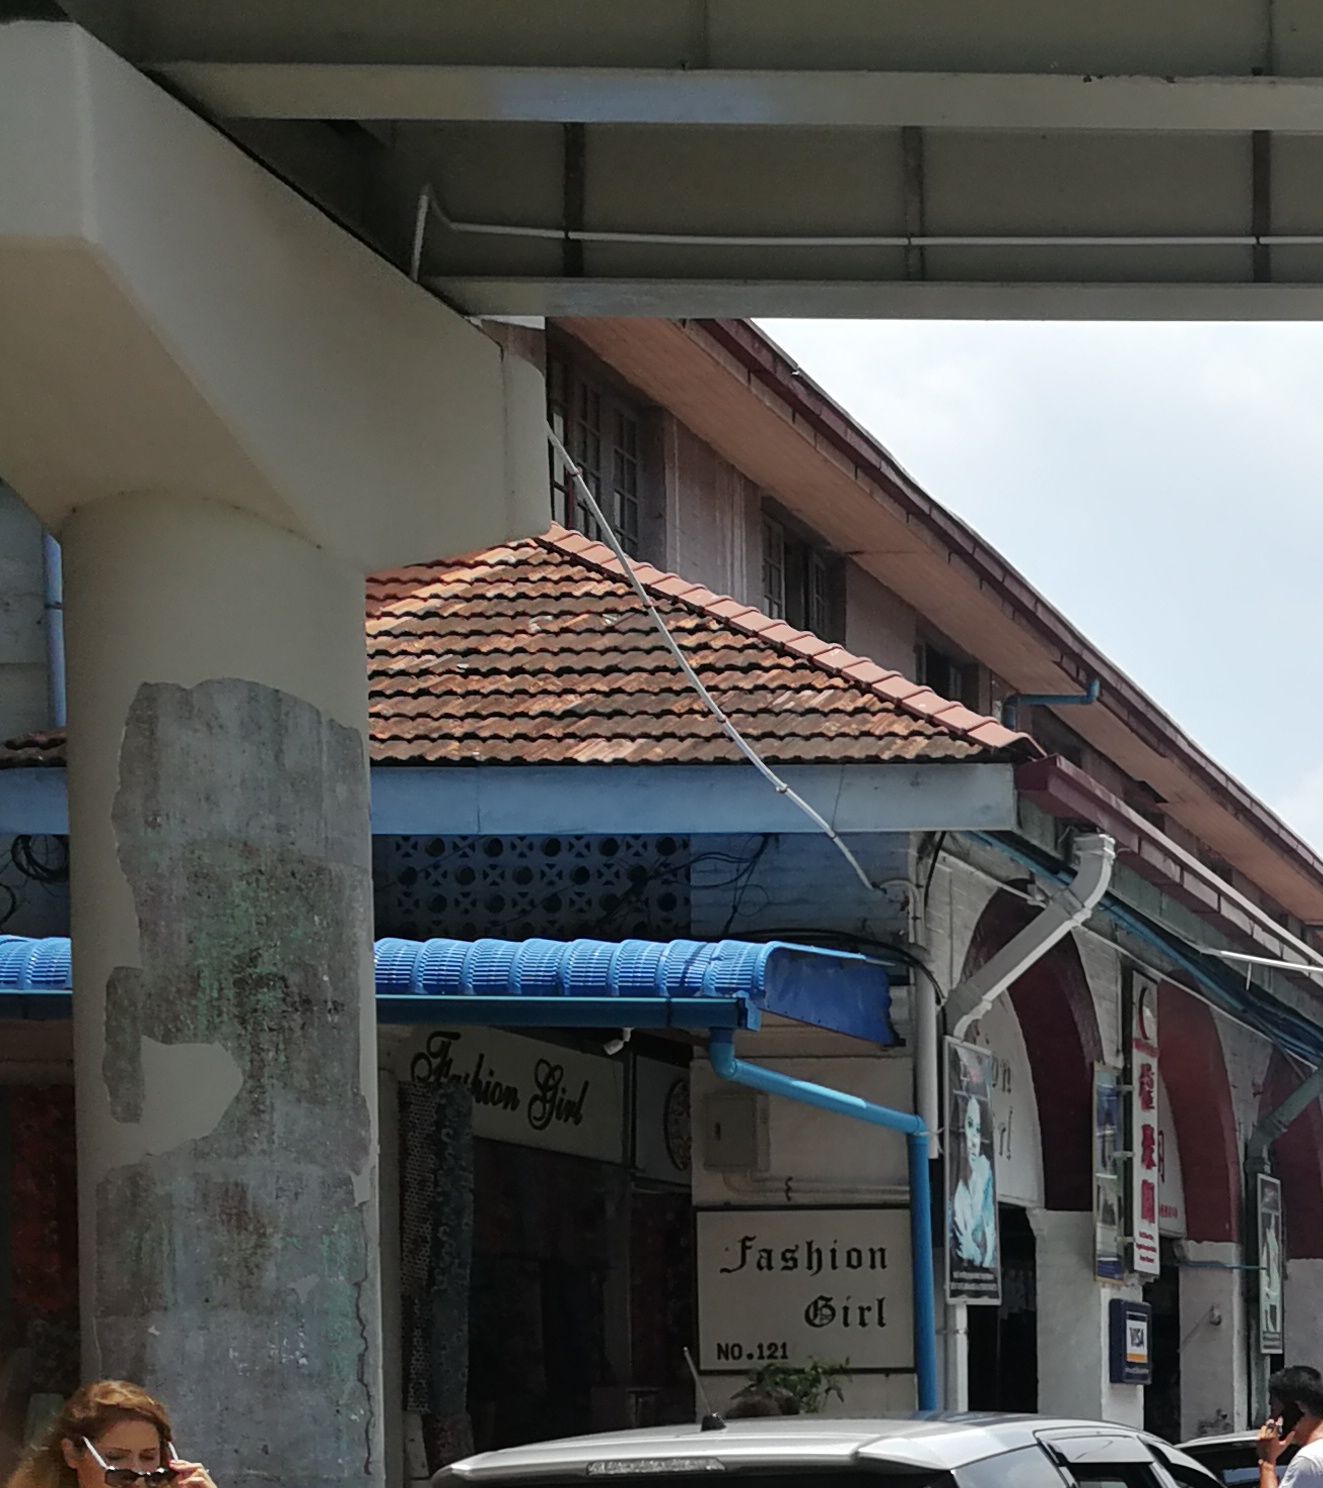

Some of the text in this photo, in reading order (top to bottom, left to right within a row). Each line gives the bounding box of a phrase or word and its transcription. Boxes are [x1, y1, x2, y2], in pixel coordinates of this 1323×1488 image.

[528, 1057, 589, 1131] Girl
[719, 1235, 888, 1278] Fashion
[804, 1295, 887, 1329] Girl
[716, 1342, 789, 1361] NO.121
